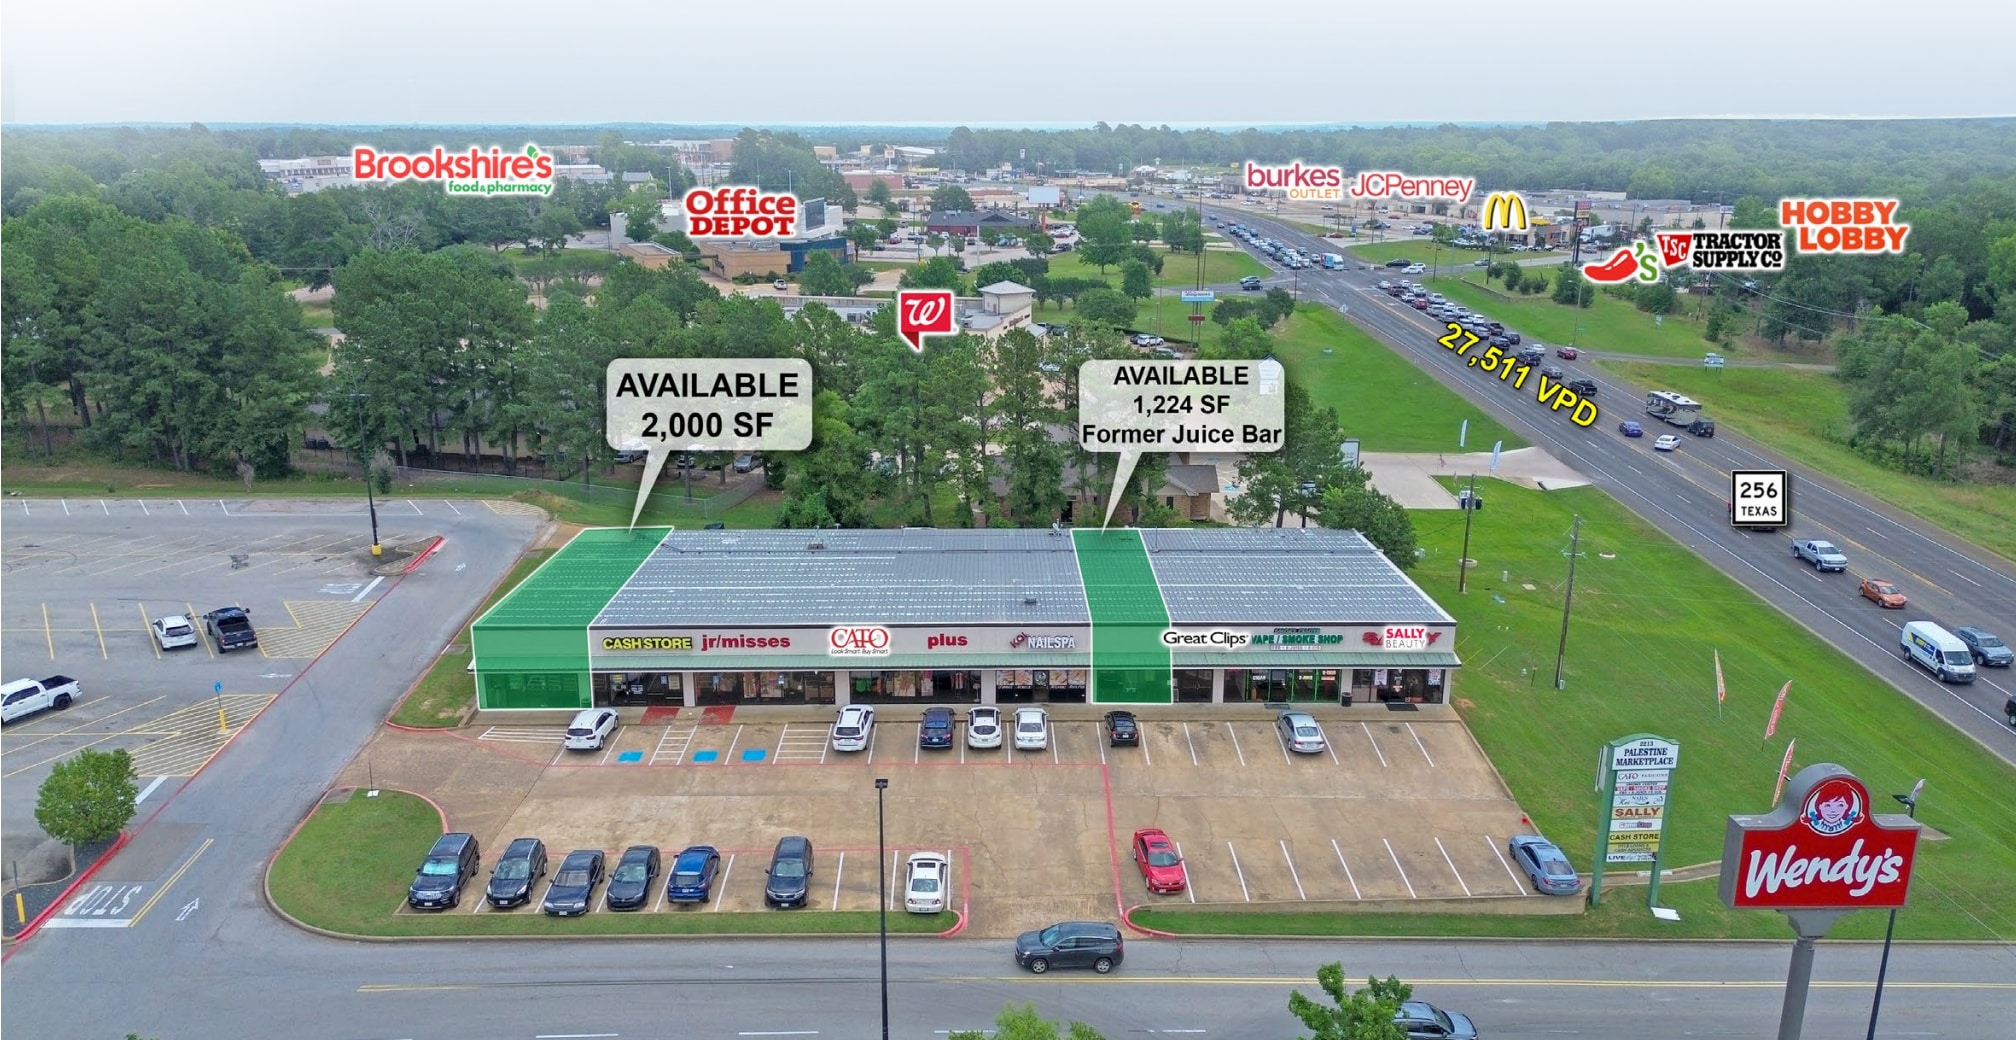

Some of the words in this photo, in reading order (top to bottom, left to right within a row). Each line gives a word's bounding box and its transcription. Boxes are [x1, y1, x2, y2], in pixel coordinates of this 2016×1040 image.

[602, 637, 643, 650] CASH
[643, 637, 693, 650] STORE
[702, 634, 791, 651] jr/misses
[928, 633, 968, 649] plus
[1251, 634, 1275, 644] VAPE
[1282, 634, 1316, 644] SMOKE
[1317, 634, 1344, 644] SHOP
[1624, 748, 1668, 757] PALESTINE
[1616, 757, 1674, 766] MARKETPLACE
[1614, 807, 1661, 817] SALLY
[1745, 838, 1903, 898] Wendy's
